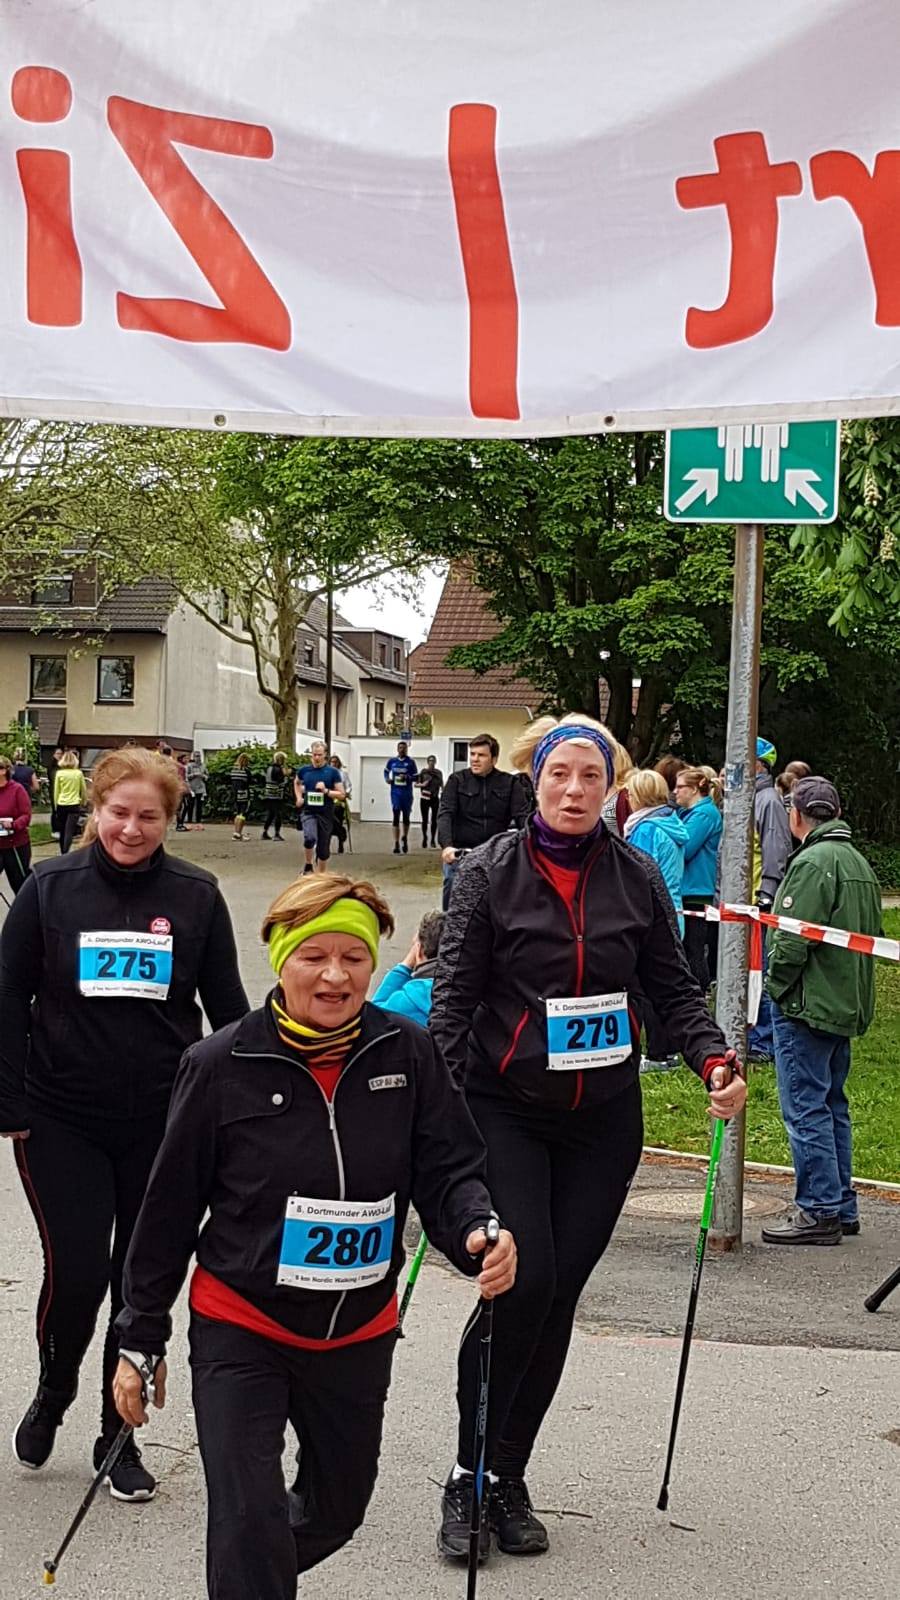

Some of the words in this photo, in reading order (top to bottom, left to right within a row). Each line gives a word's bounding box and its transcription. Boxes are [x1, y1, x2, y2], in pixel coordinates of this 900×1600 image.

[97, 950, 157, 980] 275
[566, 1014, 619, 1049] 279
[307, 1206, 360, 1217] Dortmunder
[304, 1225, 382, 1266] 280
